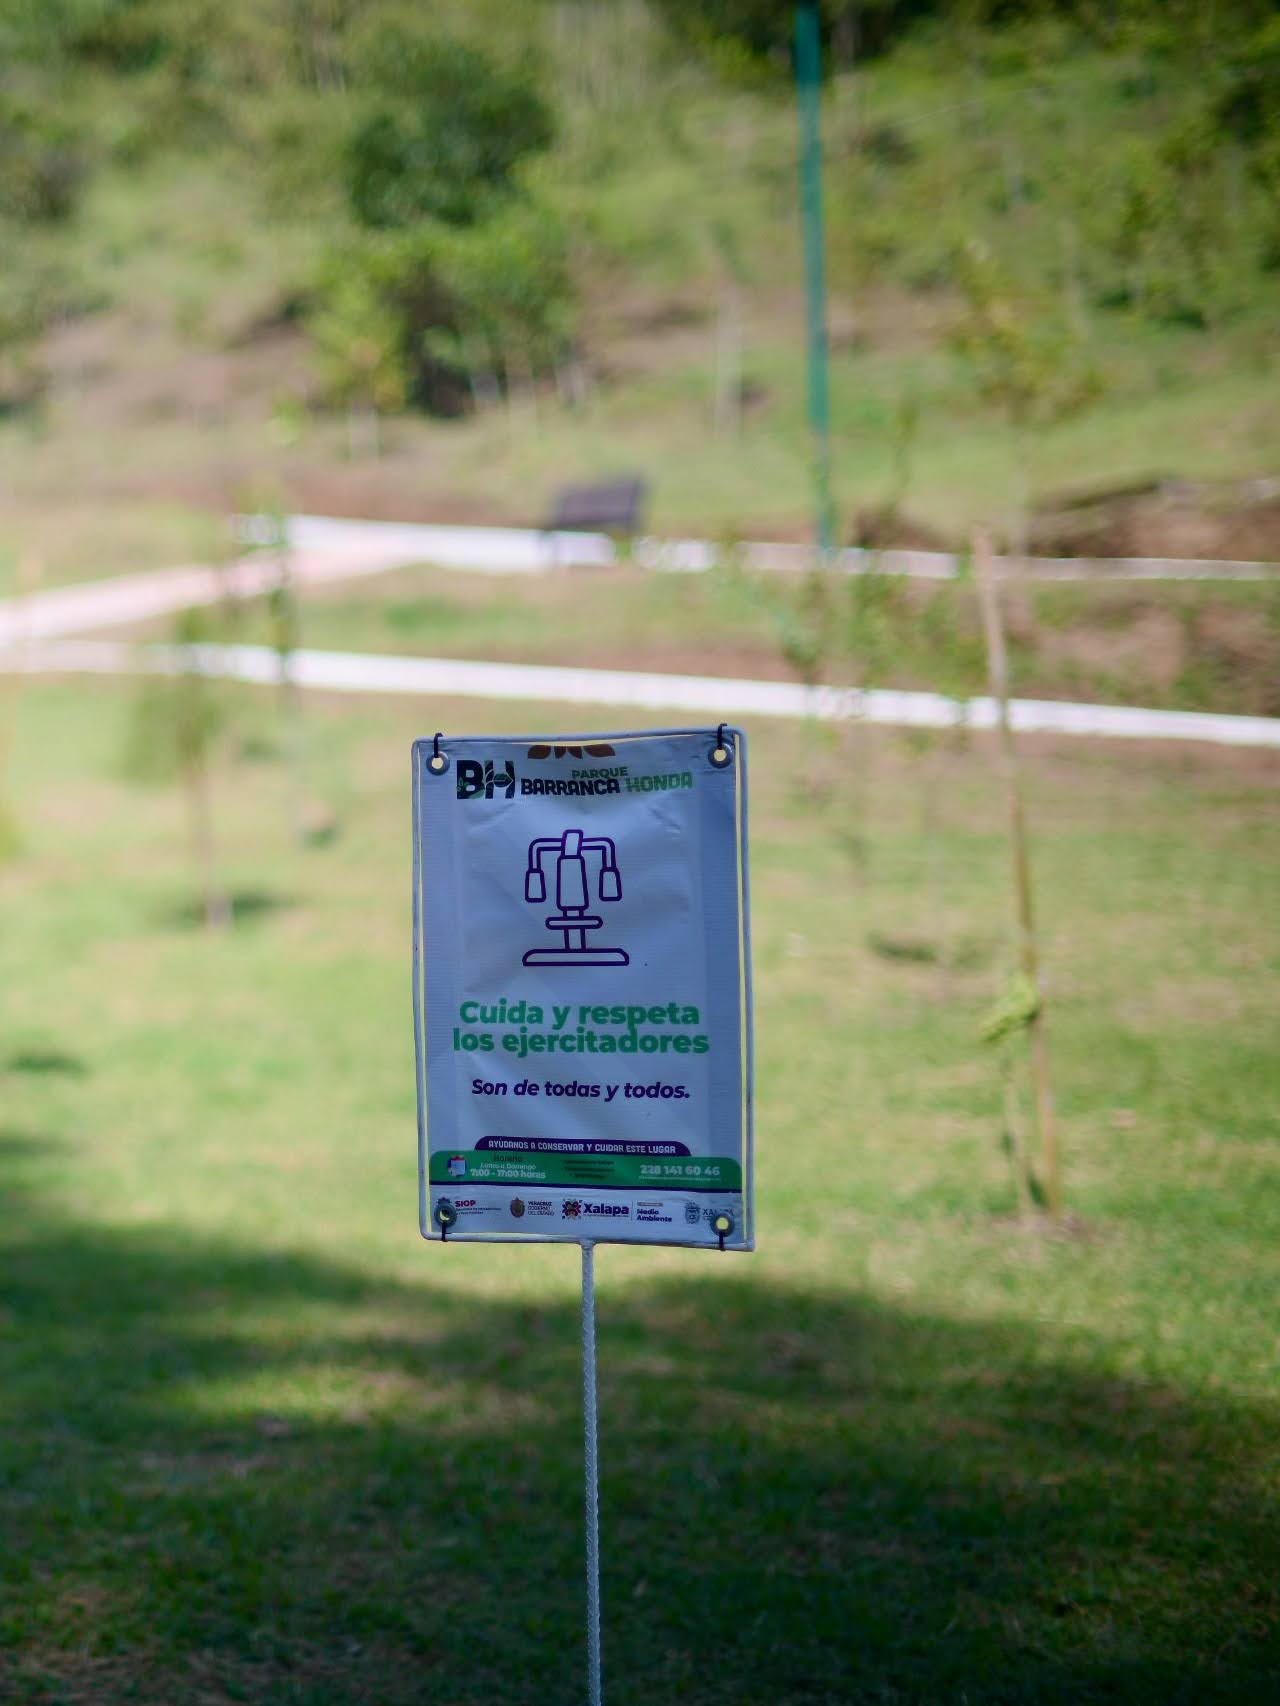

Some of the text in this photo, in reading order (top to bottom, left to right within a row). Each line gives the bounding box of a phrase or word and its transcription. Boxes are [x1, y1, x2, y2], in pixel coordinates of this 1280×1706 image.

[456, 759, 516, 800] BH
[572, 766, 629, 780] PARQUE
[520, 770, 693, 796] BARRANCA HONDA
[459, 998, 700, 1030] Cuida y respeta
[453, 1026, 710, 1058] los ejercitadores
[471, 1078, 691, 1103] Son de todas y todos.
[530, 1142, 536, 1150] A
[537, 1143, 584, 1151] CONSERVAR
[586, 1144, 593, 1152] Y
[595, 1144, 624, 1153] CUIDAR
[626, 1145, 646, 1153] ESTE
[648, 1145, 676, 1154] LUGAR
[520, 1170, 546, 1179] horas
[704, 1166, 720, 1176] 46
[583, 1203, 629, 1216] Xalapa
